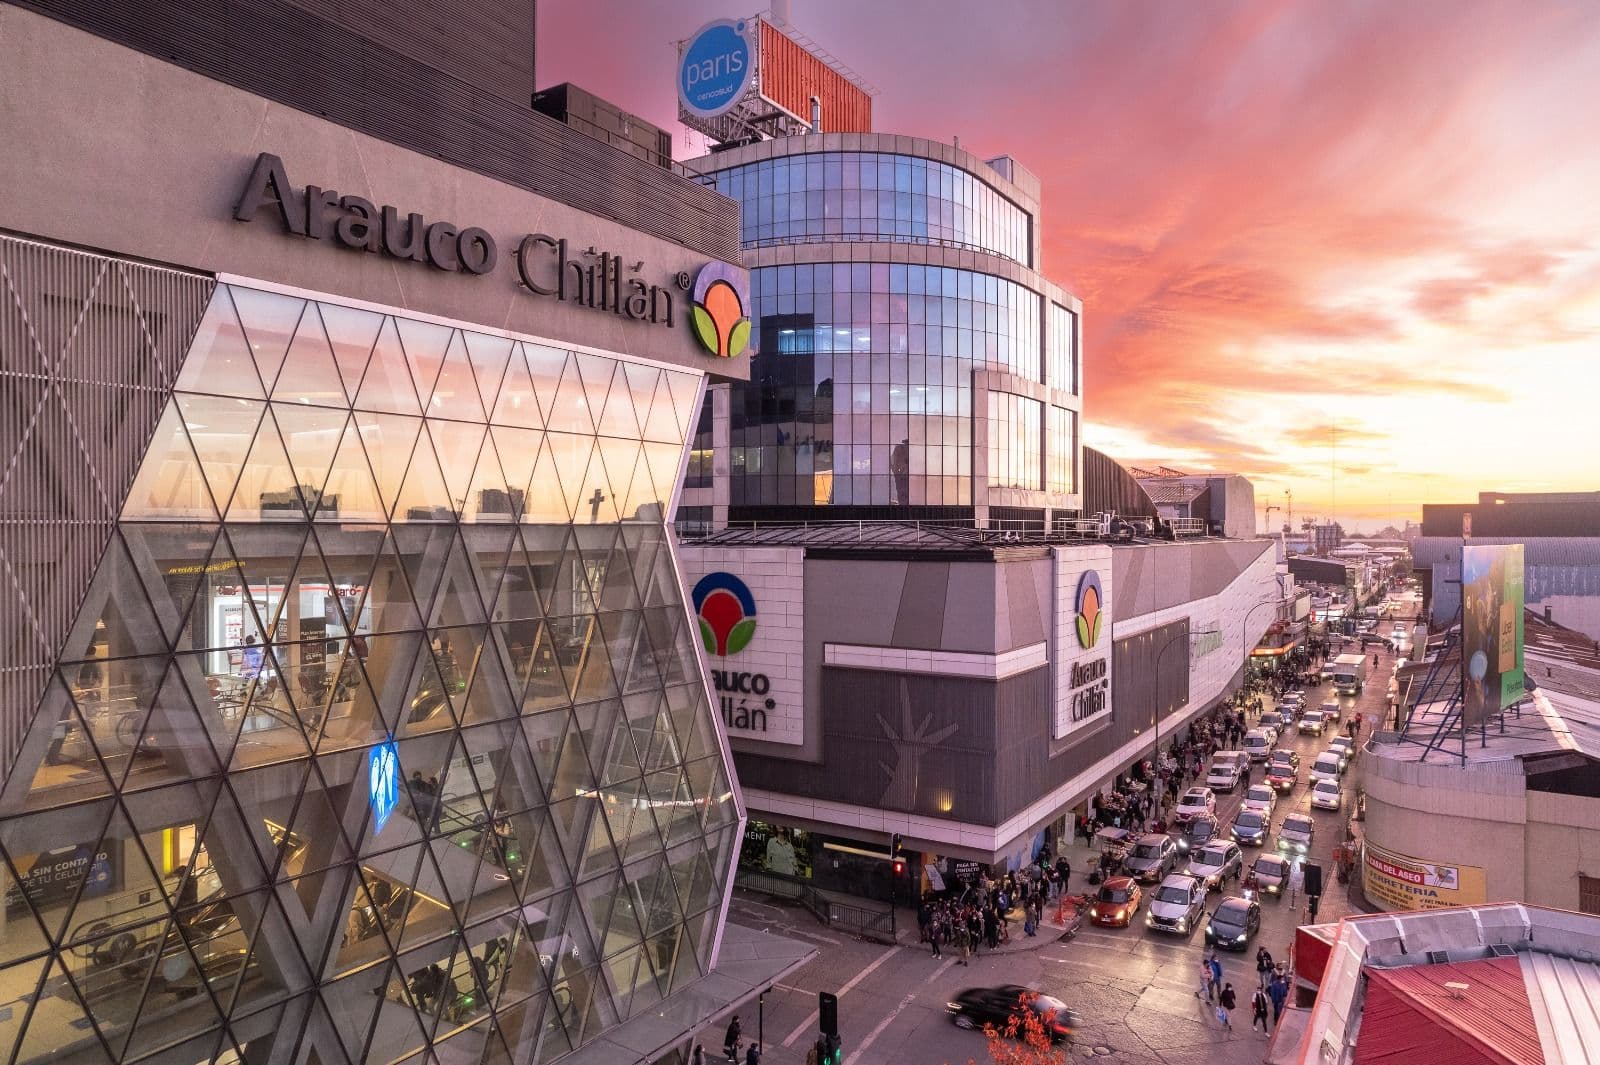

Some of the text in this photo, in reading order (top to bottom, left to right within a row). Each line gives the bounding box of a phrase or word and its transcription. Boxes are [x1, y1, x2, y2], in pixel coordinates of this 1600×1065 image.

[687, 50, 743, 92] paris
[233, 152, 498, 275] Arauco
[327, 586, 357, 598] Caro
[1071, 657, 1106, 689] Arauco
[33, 865, 52, 877] SIN
[55, 852, 108, 872] CONTATO
[1383, 864, 1397, 876] DEL
[1398, 870, 1421, 883] ASEO
